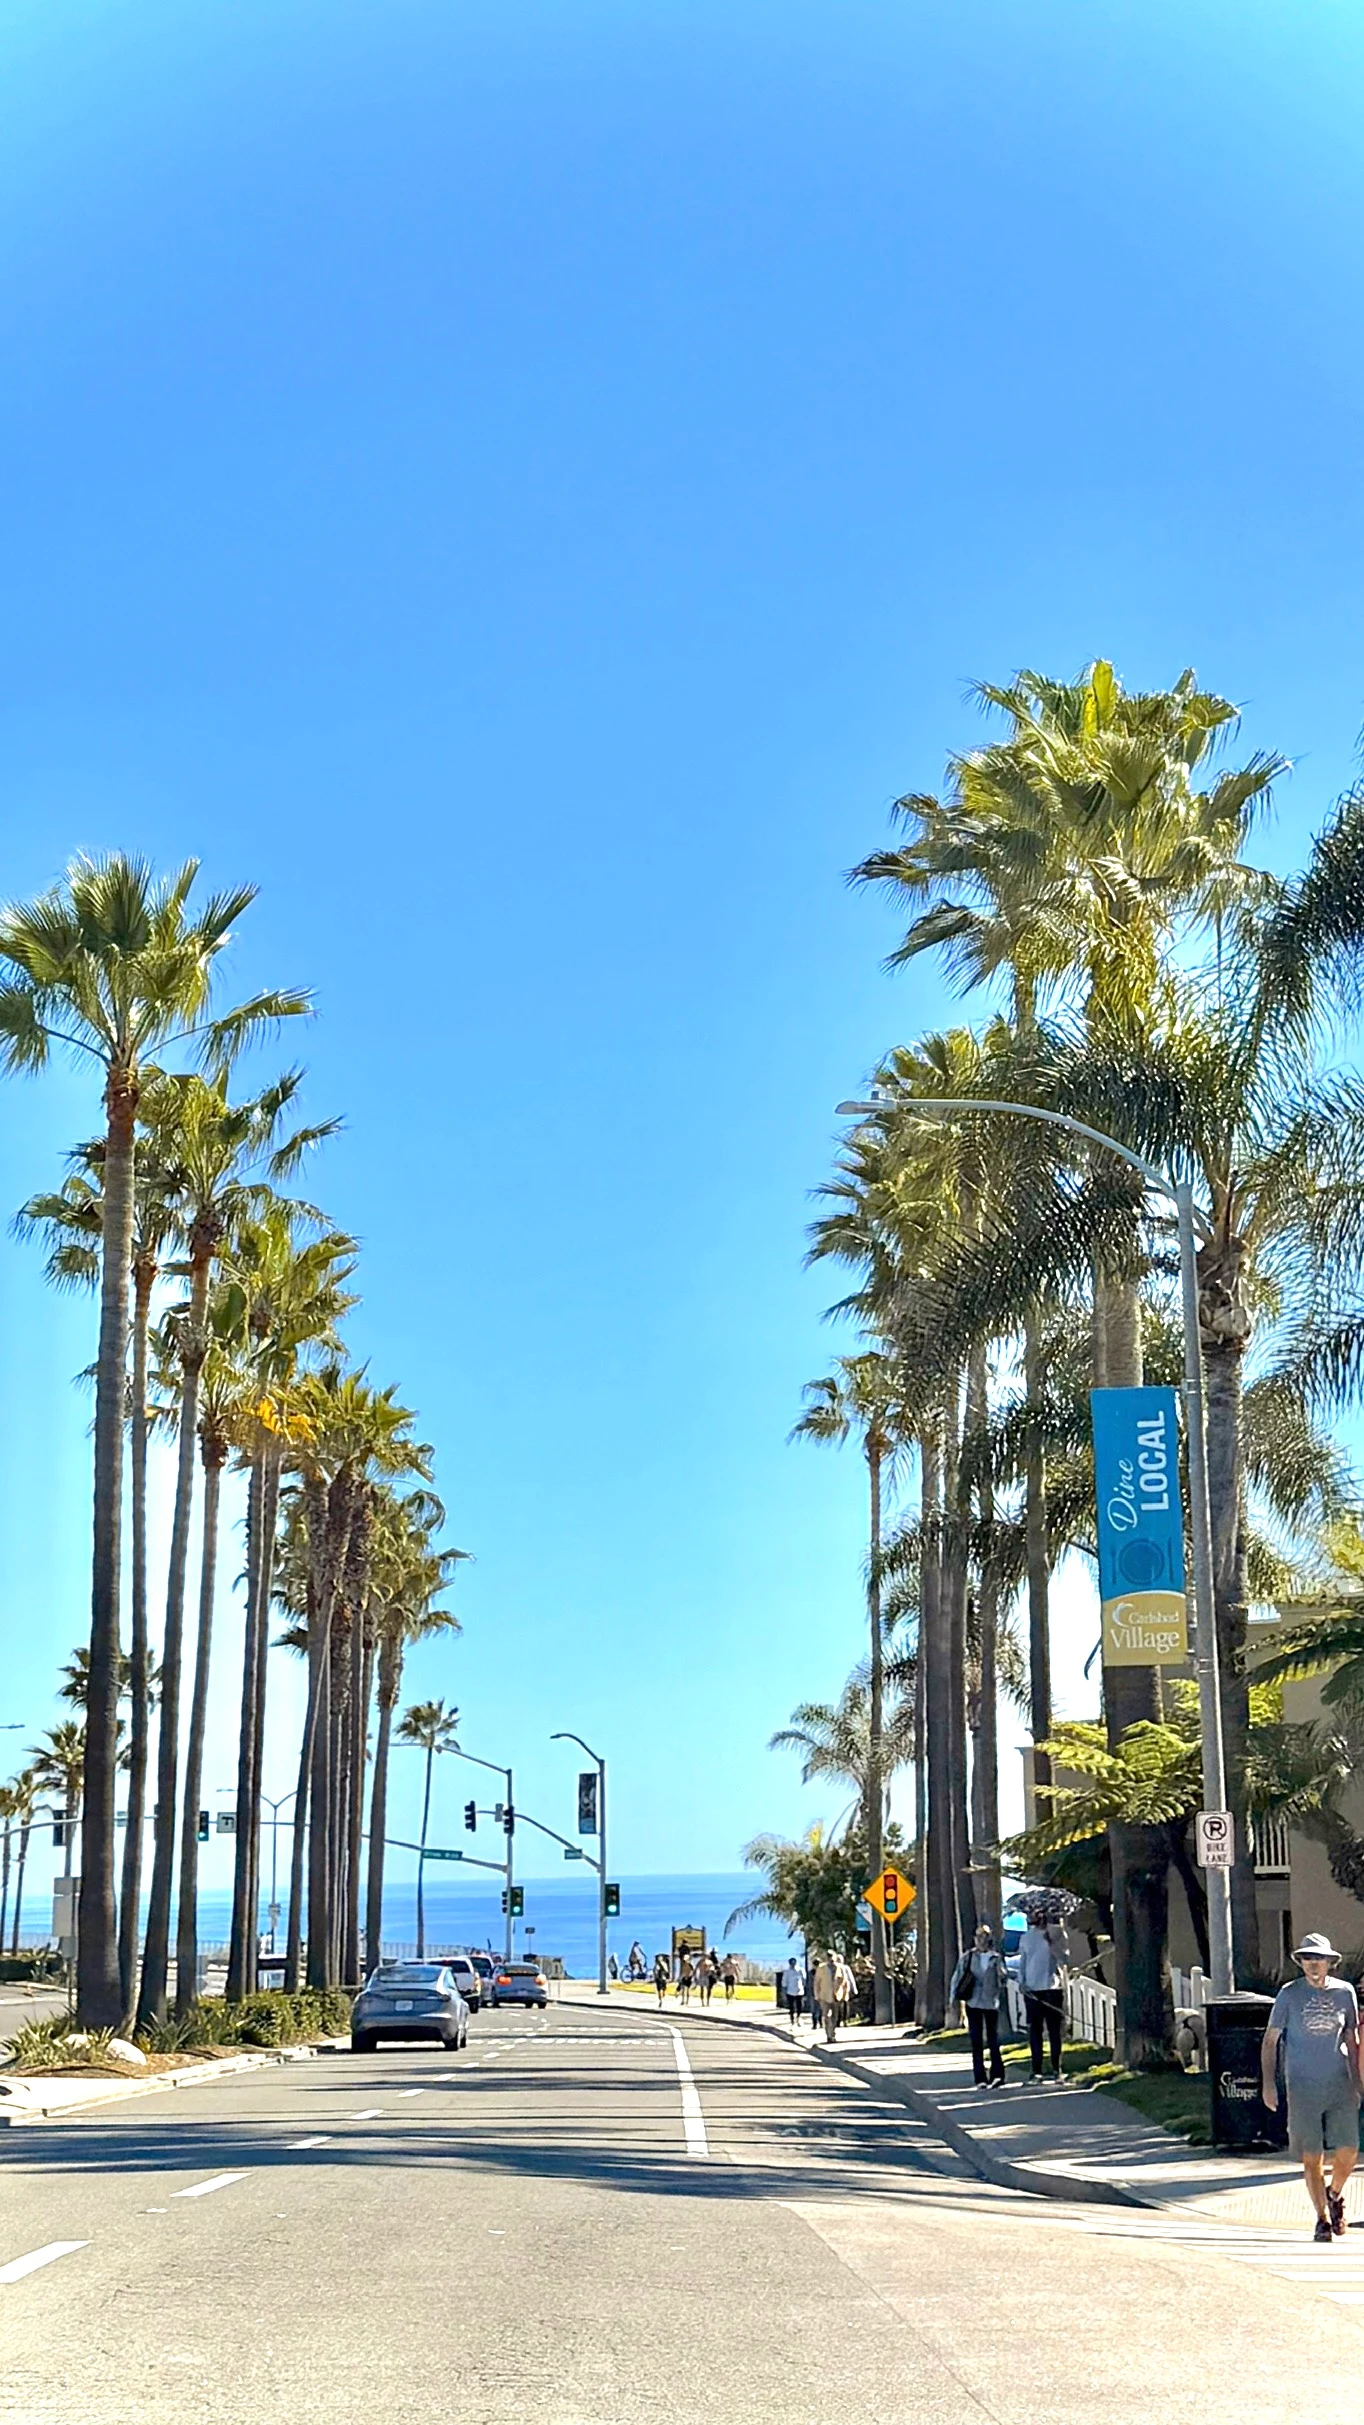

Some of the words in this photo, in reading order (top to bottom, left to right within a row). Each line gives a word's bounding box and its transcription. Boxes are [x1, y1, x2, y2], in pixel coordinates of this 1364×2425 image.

[1107, 1457, 1138, 1532] Dine
[1137, 1410, 1170, 1511] LOCAL
[1110, 1626, 1180, 1654] Village
